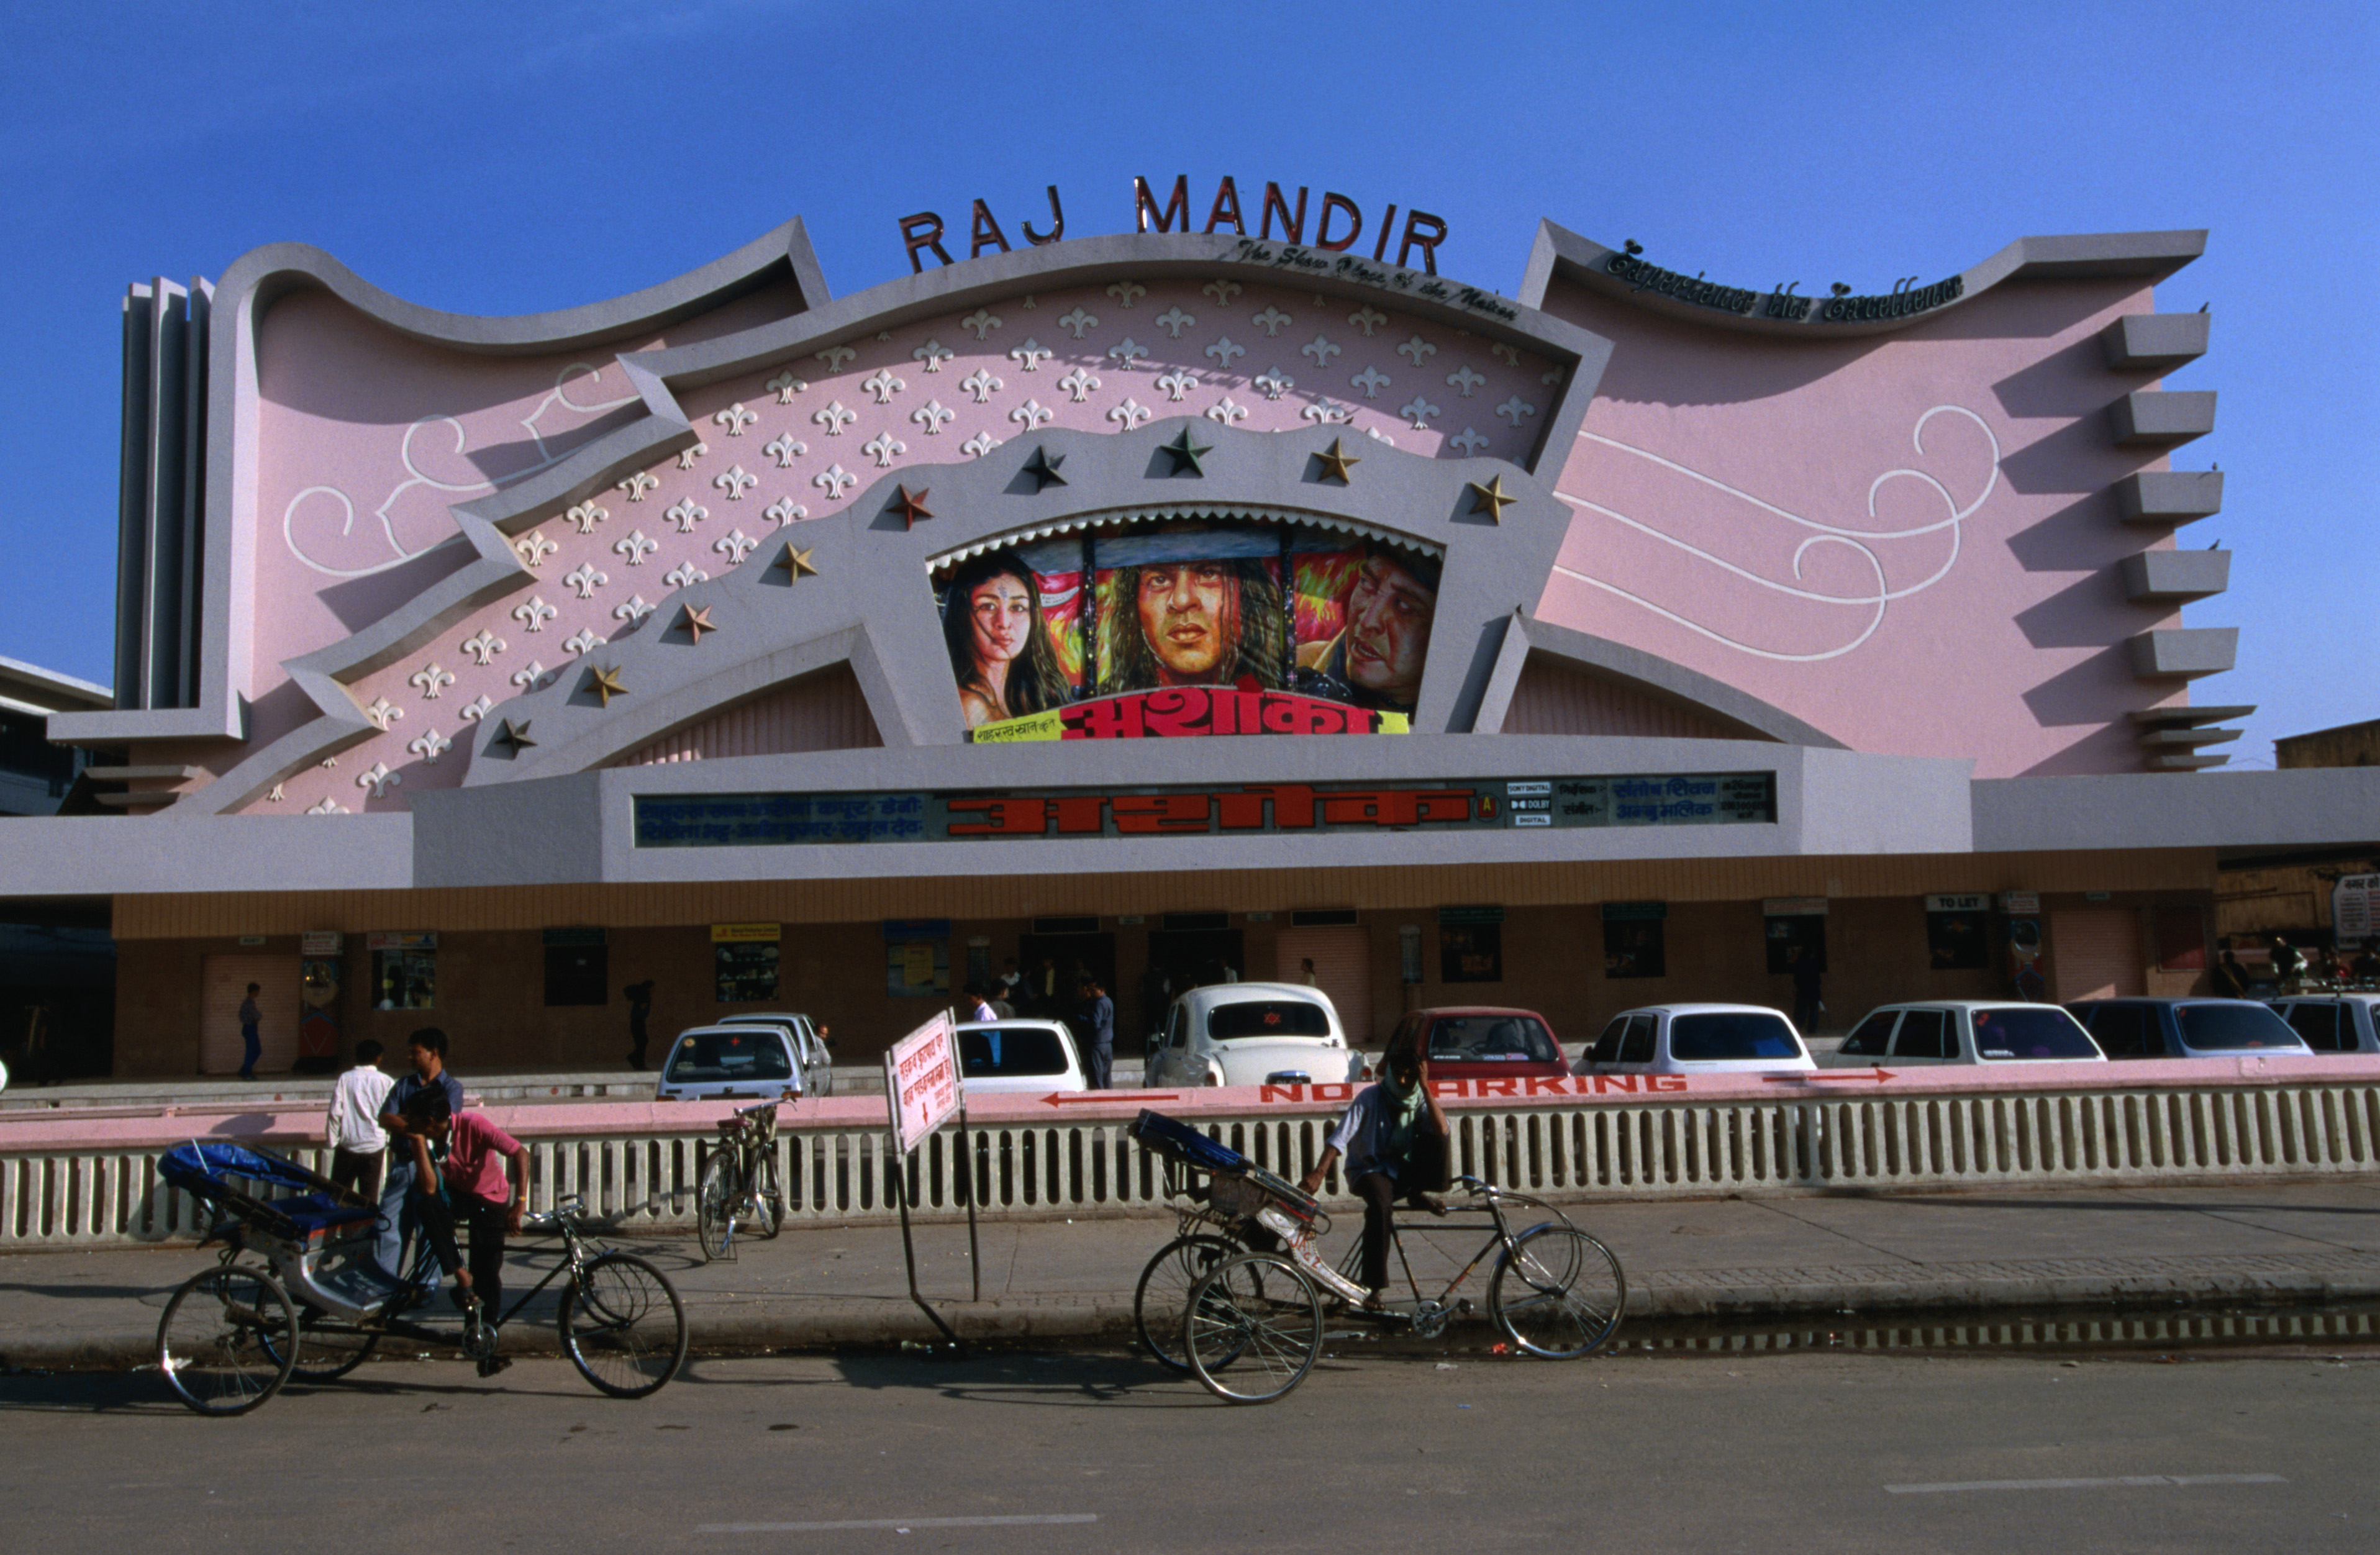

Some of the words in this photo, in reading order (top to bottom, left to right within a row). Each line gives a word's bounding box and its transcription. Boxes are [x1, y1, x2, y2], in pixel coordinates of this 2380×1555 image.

[898, 185, 1065, 274] RAJ
[1133, 175, 1448, 275] MANDIR
[1238, 240, 1271, 261] The
[1278, 247, 1328, 269] Show
[1337, 256, 1386, 284] Place
[1393, 271, 1415, 288] of
[1419, 281, 1448, 299] the
[1460, 287, 1517, 321] Nation
[1607, 239, 1758, 315] Experience
[1769, 281, 1811, 320] the
[1824, 274, 1964, 322] Excellence
[1508, 784, 1525, 792] SONY
[1525, 784, 1550, 792] DIGITAL
[1528, 800, 1550, 809] DOLBY
[1939, 896, 1955, 909] TO
[1958, 896, 1979, 908] LET
[1260, 1083, 1353, 1103] NO
[1430, 1074, 1687, 1099] ARKING
